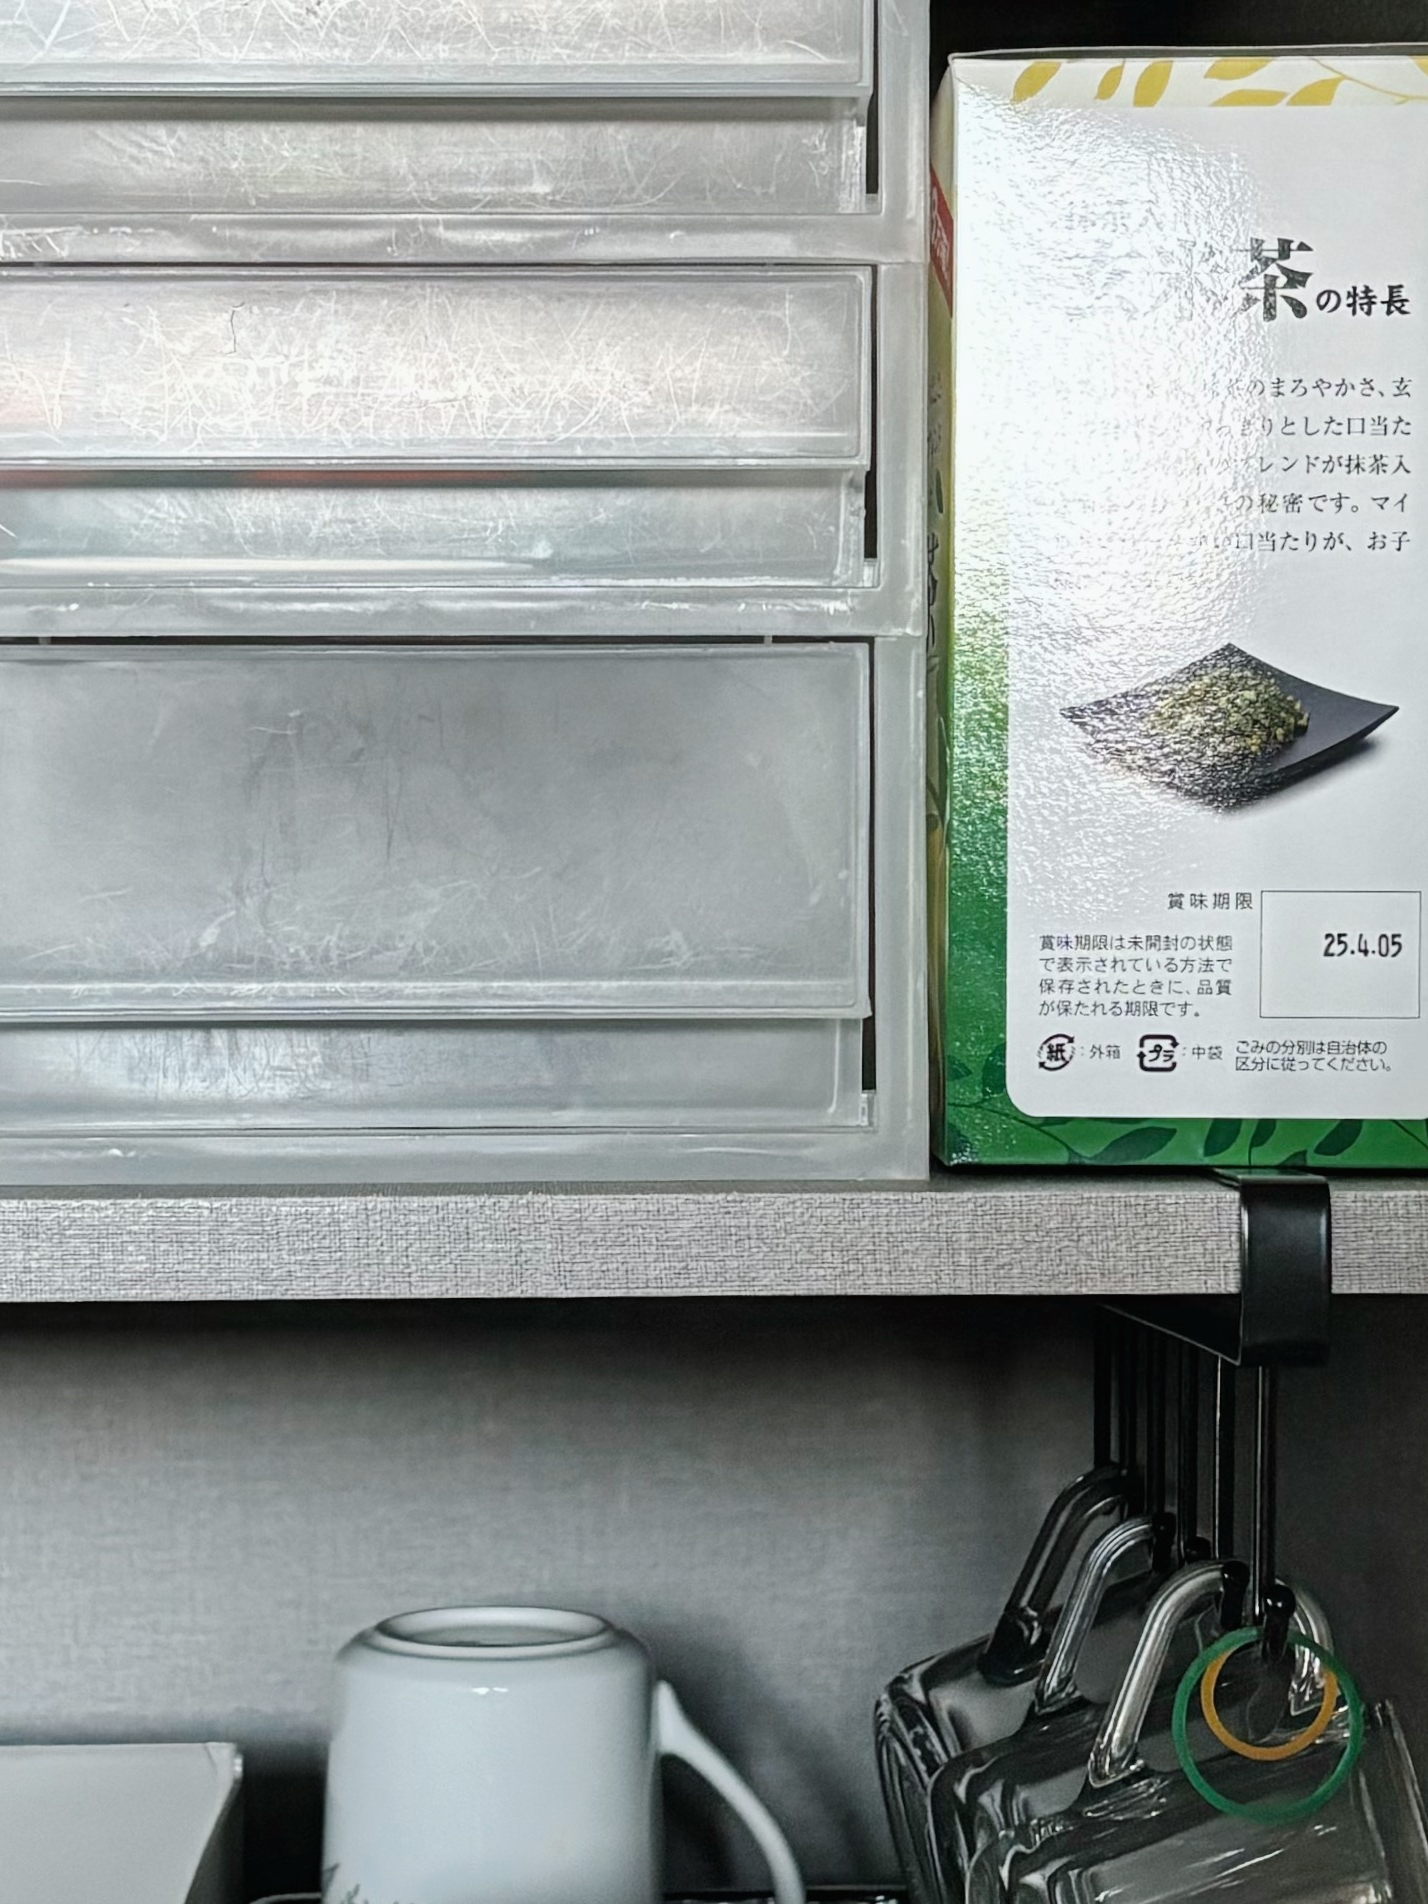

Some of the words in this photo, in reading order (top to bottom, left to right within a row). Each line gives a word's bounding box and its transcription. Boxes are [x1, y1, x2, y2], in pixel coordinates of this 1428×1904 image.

[1167, 892, 1254, 911] 賞味期限
[1039, 934, 1234, 952] 賞味期限は未開封の状態
[1322, 932, 1404, 959] 25.4.05
[1039, 956, 1233, 974] で表示されている方法で
[1039, 978, 1233, 996] 保存されたときに、品質
[1038, 1000, 1201, 1018] が保たれる期限です。
